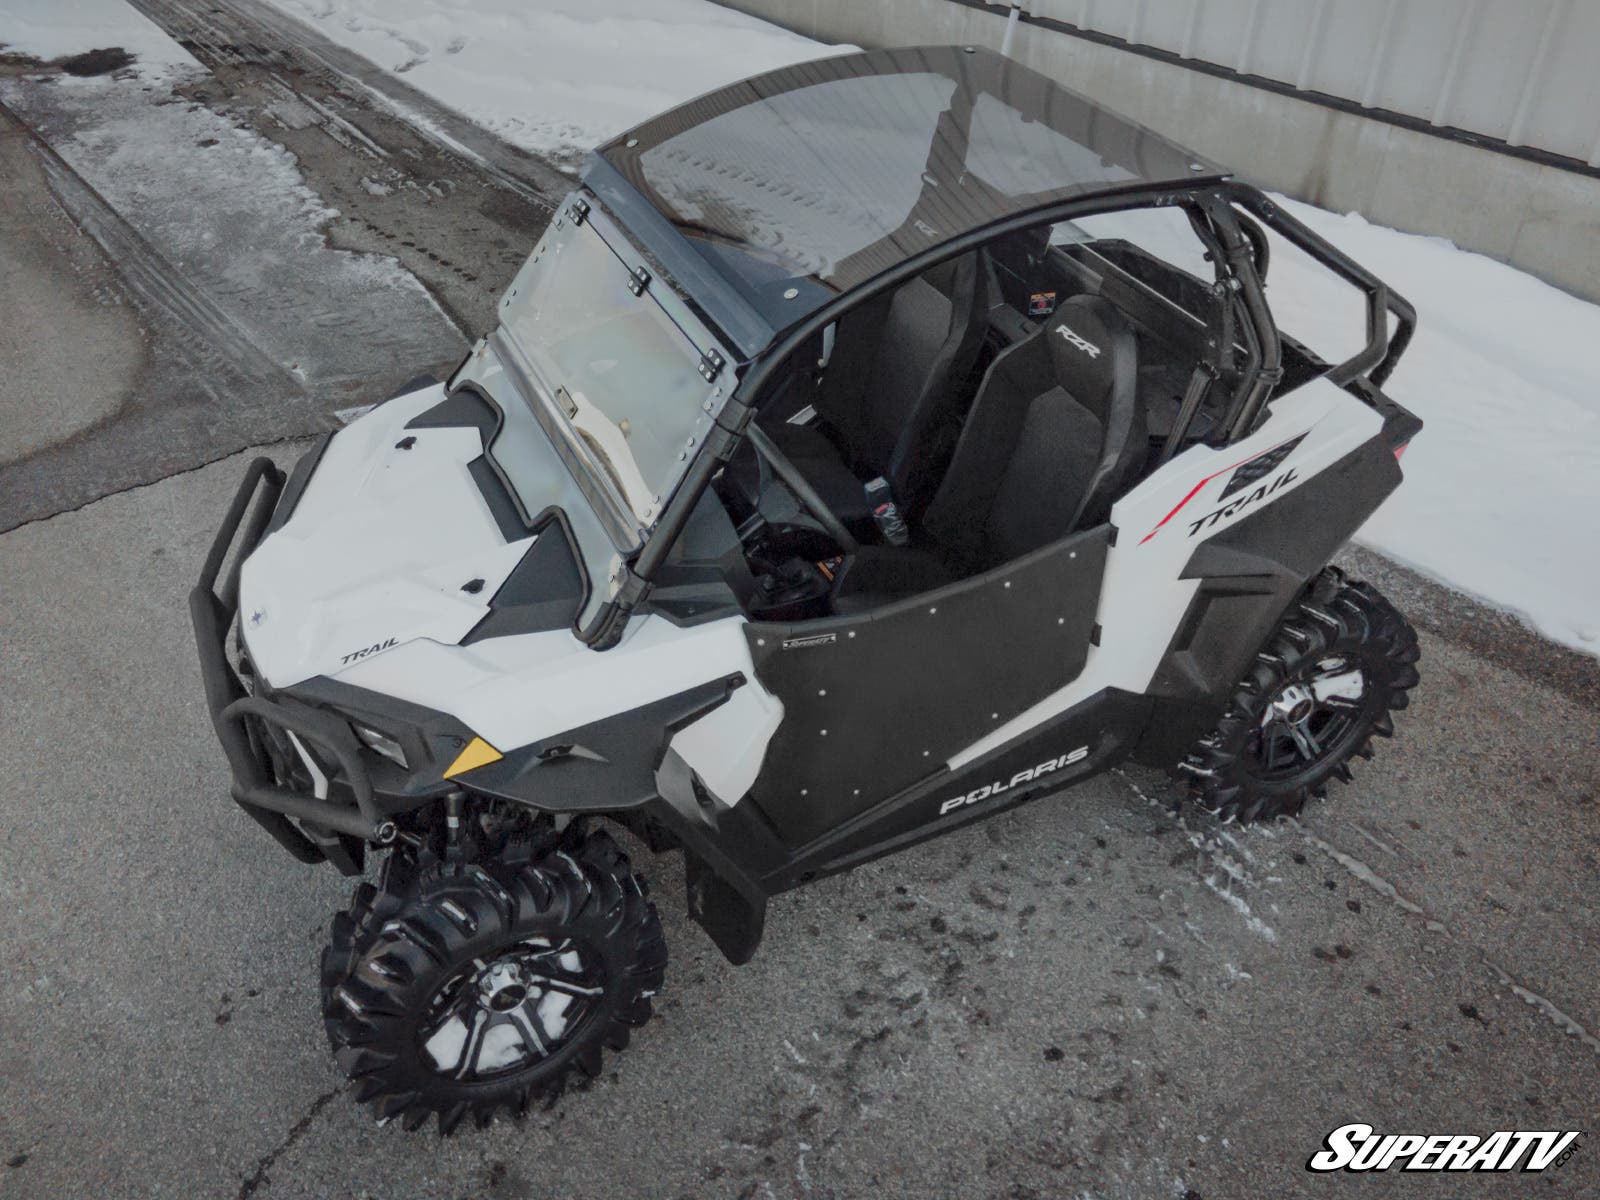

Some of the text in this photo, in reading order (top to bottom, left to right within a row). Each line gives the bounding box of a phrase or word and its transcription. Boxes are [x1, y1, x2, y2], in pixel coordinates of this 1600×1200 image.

[1055, 324, 1101, 359] RZR
[1188, 467, 1299, 537] TRAIL
[341, 637, 400, 664] TRAIL
[939, 745, 1089, 815] POLARIS
